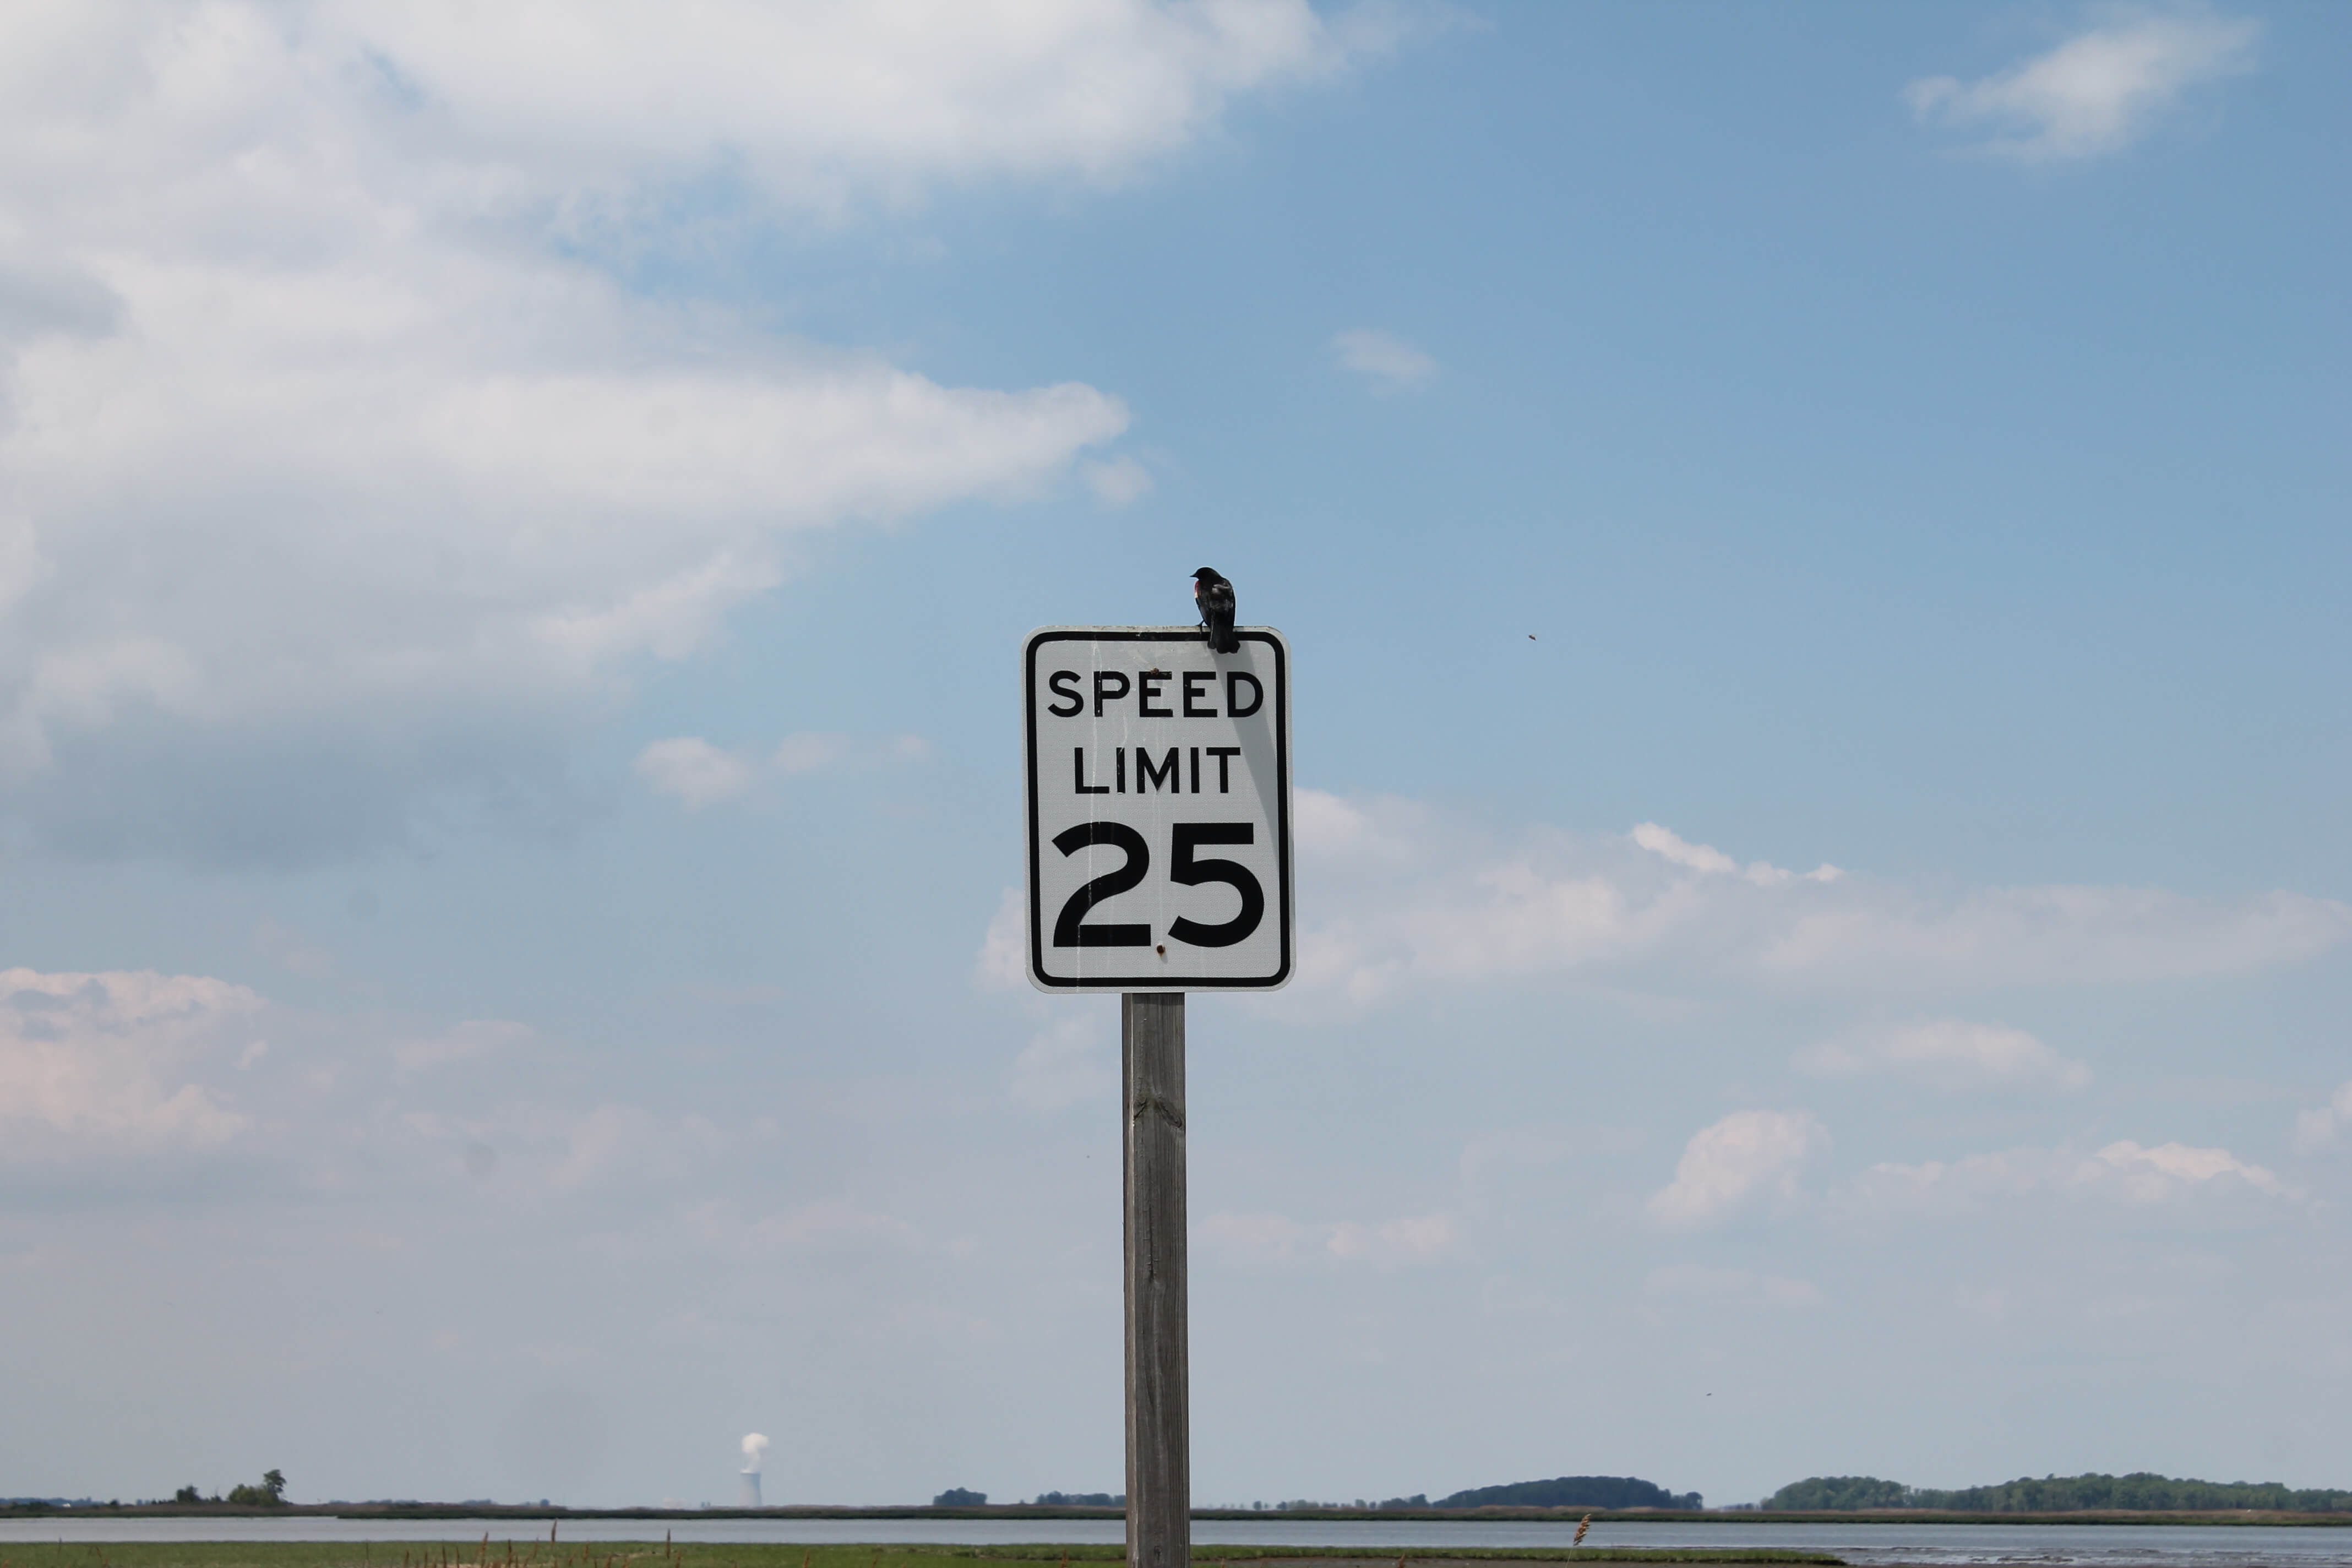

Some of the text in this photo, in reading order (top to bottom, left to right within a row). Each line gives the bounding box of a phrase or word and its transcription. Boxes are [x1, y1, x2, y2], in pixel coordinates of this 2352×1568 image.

[1047, 670, 1264, 718] SPEED
[1074, 747, 1241, 794] LIMIT
[1051, 821, 1265, 948] 25
